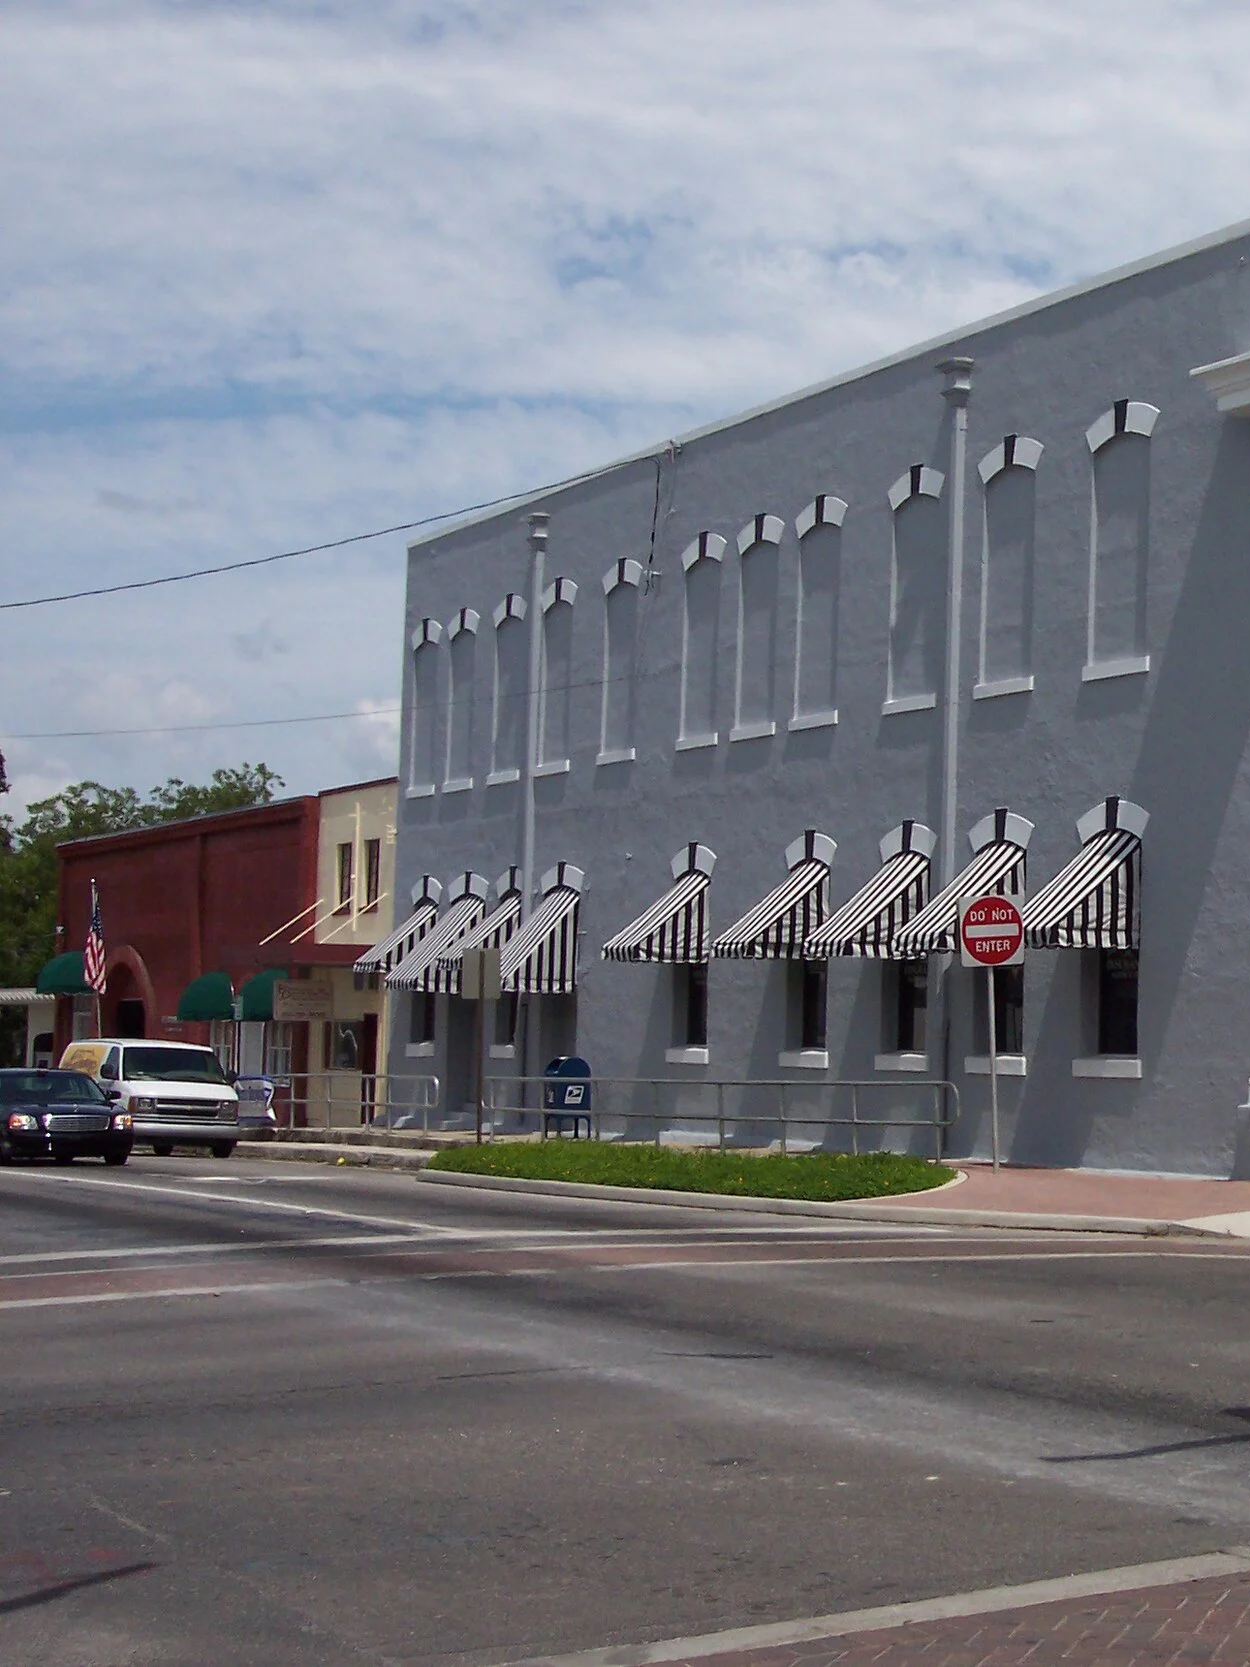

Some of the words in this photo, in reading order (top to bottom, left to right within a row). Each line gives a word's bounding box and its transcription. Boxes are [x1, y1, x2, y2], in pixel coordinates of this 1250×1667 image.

[970, 910, 986, 922] DO
[992, 908, 1014, 921] NOT
[975, 940, 1011, 953] ENTER
